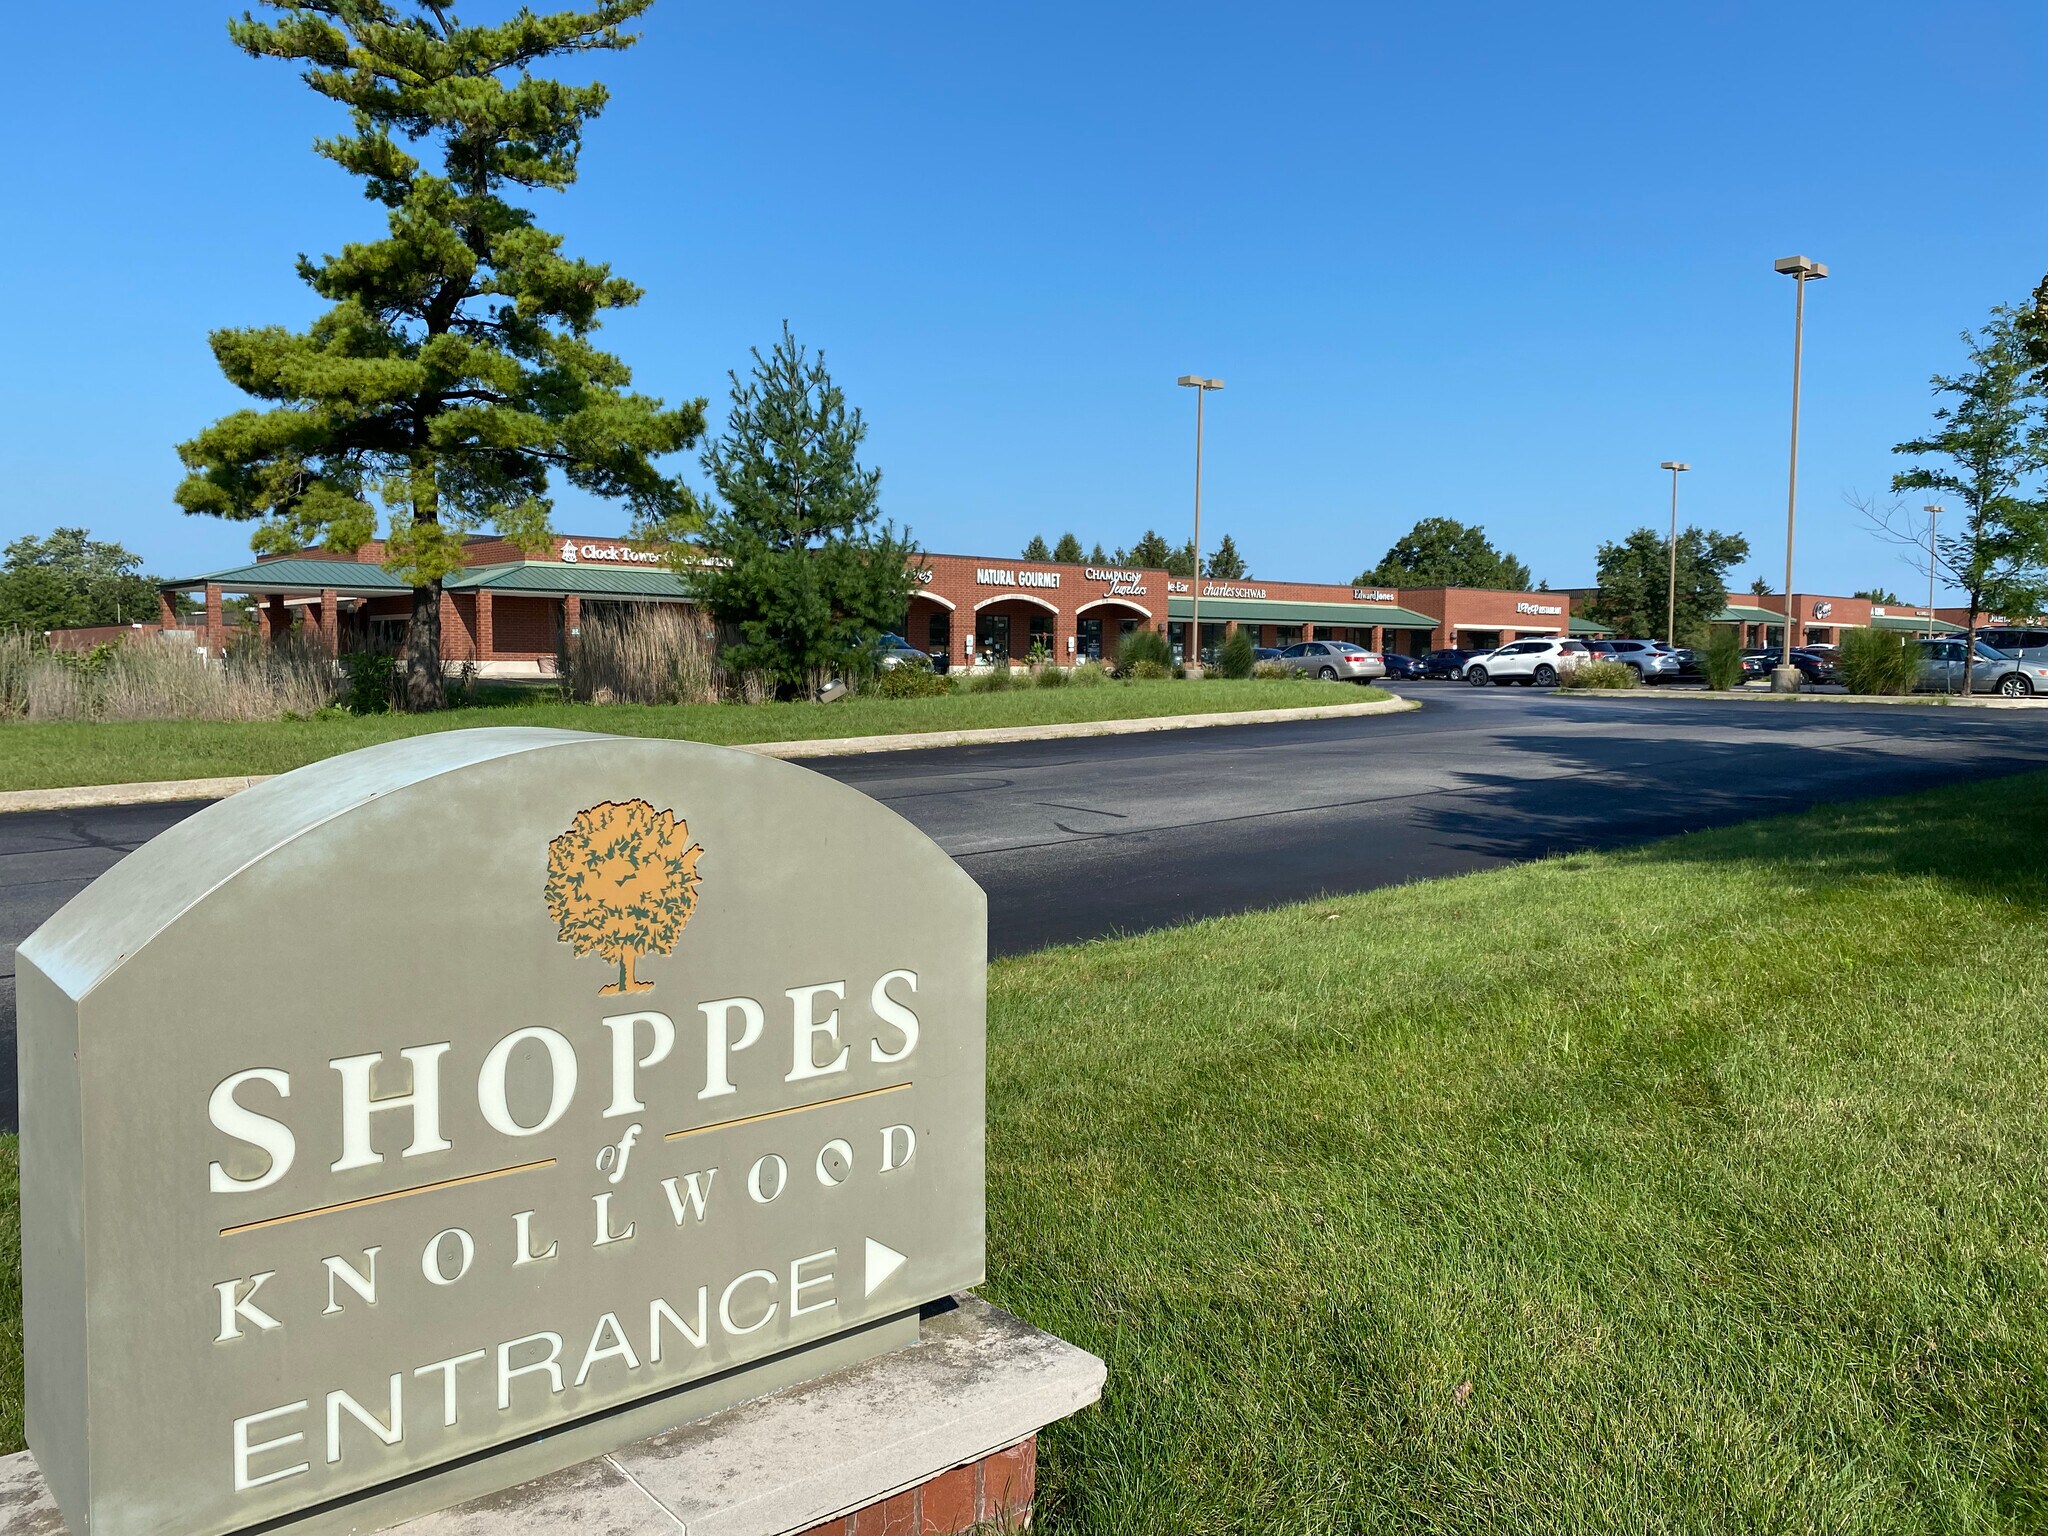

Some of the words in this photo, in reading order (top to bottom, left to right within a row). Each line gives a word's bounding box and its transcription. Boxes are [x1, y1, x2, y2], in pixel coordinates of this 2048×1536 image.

[581, 545, 619, 561] Clock
[621, 547, 661, 563] Tower
[976, 568, 1016, 586] NATURAL
[1018, 571, 1060, 588] GOURMET
[1085, 568, 1140, 581] CHAMPAIGN
[1104, 574, 1146, 597] Jewelers
[1203, 583, 1235, 597] charles
[1235, 588, 1266, 599] SCHWAB
[208, 969, 920, 1194] SHOPPES
[595, 1124, 644, 1184] of
[213, 1124, 918, 1342] KNOLLWOOD
[232, 1247, 839, 1491] ENTRANCE
